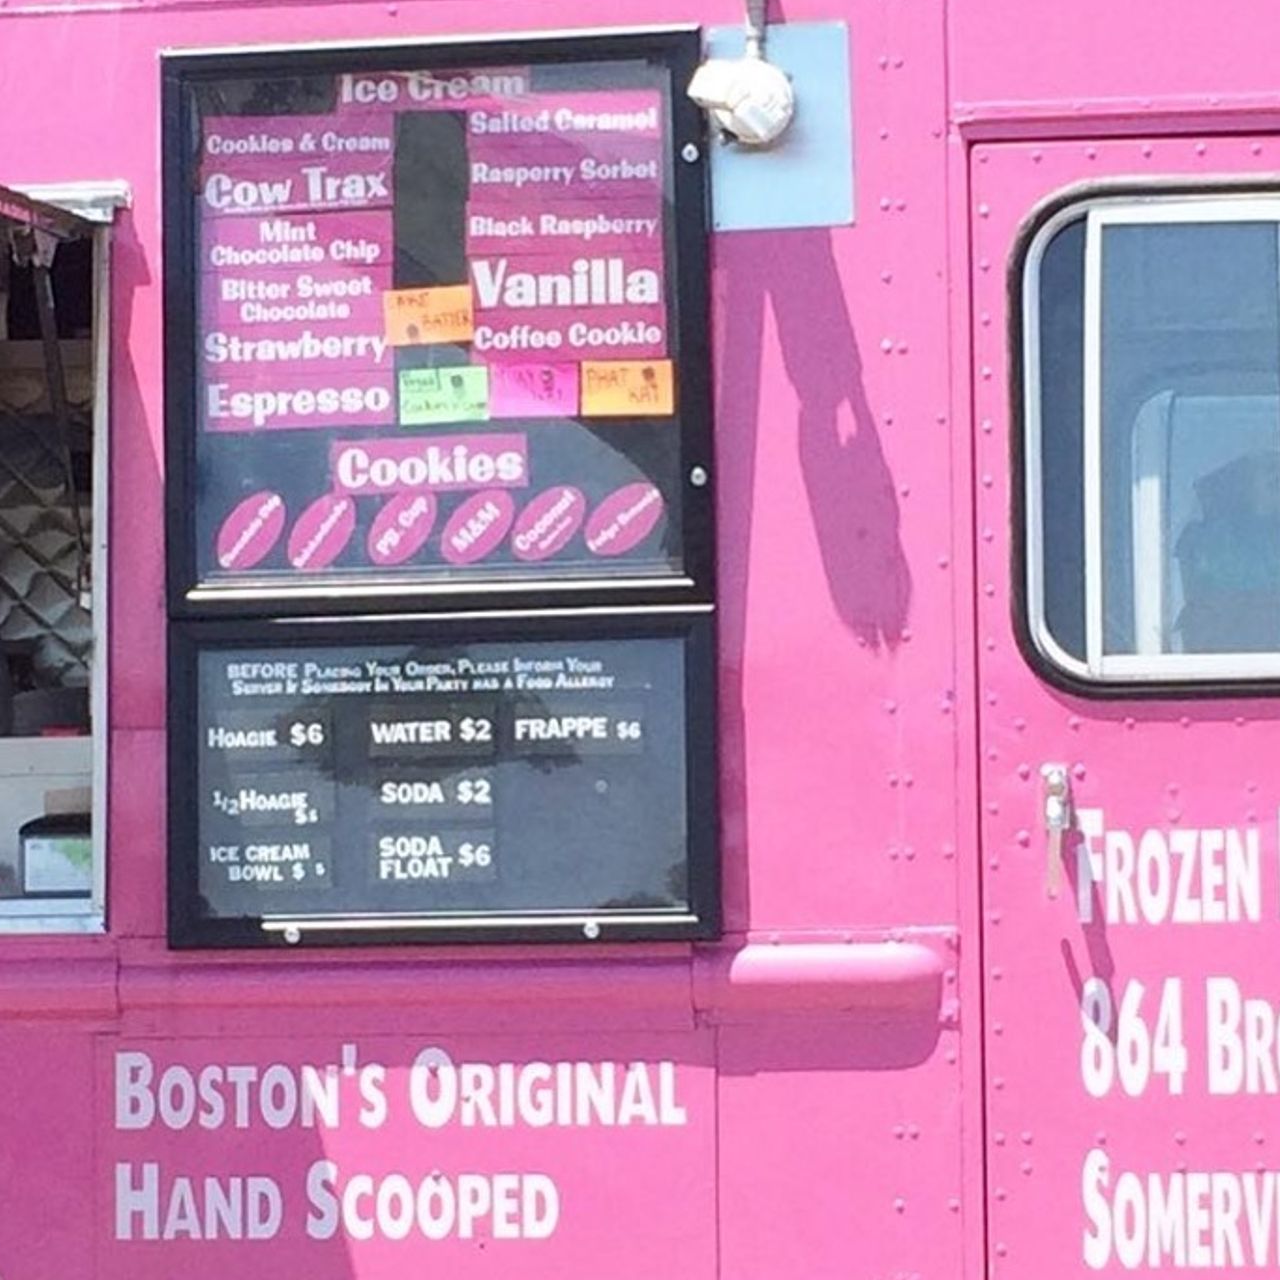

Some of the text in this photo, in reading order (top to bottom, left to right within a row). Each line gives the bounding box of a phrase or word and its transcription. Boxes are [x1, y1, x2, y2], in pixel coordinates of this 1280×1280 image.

[342, 70, 524, 102] Ice Cream
[471, 107, 658, 133] Salted Caramel
[207, 131, 391, 154] Cookies & Cream
[580, 158, 657, 180] Sorbet
[205, 166, 388, 208] Cow Trax
[260, 220, 317, 242] Mint
[470, 214, 658, 240] Black Raspberry
[211, 239, 381, 266] Chocolate Chip
[221, 274, 372, 301] Bitter Sweet
[472, 257, 659, 308] Vanilla
[240, 301, 351, 323] Chocolate
[205, 330, 387, 364] Strawberry
[474, 321, 662, 351] Coffee Cookie
[208, 384, 390, 427] Espresso
[337, 443, 524, 489] Cookies
[227, 661, 299, 679] BEFORE
[208, 721, 324, 748] HOAGIE $6
[370, 717, 492, 744] WATER $2
[514, 717, 641, 741] FRAPPE $6
[380, 778, 492, 805] SODA $2
[210, 843, 310, 863] ICE CREAM
[379, 835, 445, 858] SODA
[228, 864, 284, 881] BOWL
[380, 841, 492, 880] FLOAT $6
[1075, 808, 1261, 924] FROZEN
[1081, 976, 1188, 1097] 864
[115, 1044, 687, 1130] BOSTON'S ORIGINAL
[115, 1160, 560, 1240] HAND SCOOPED
